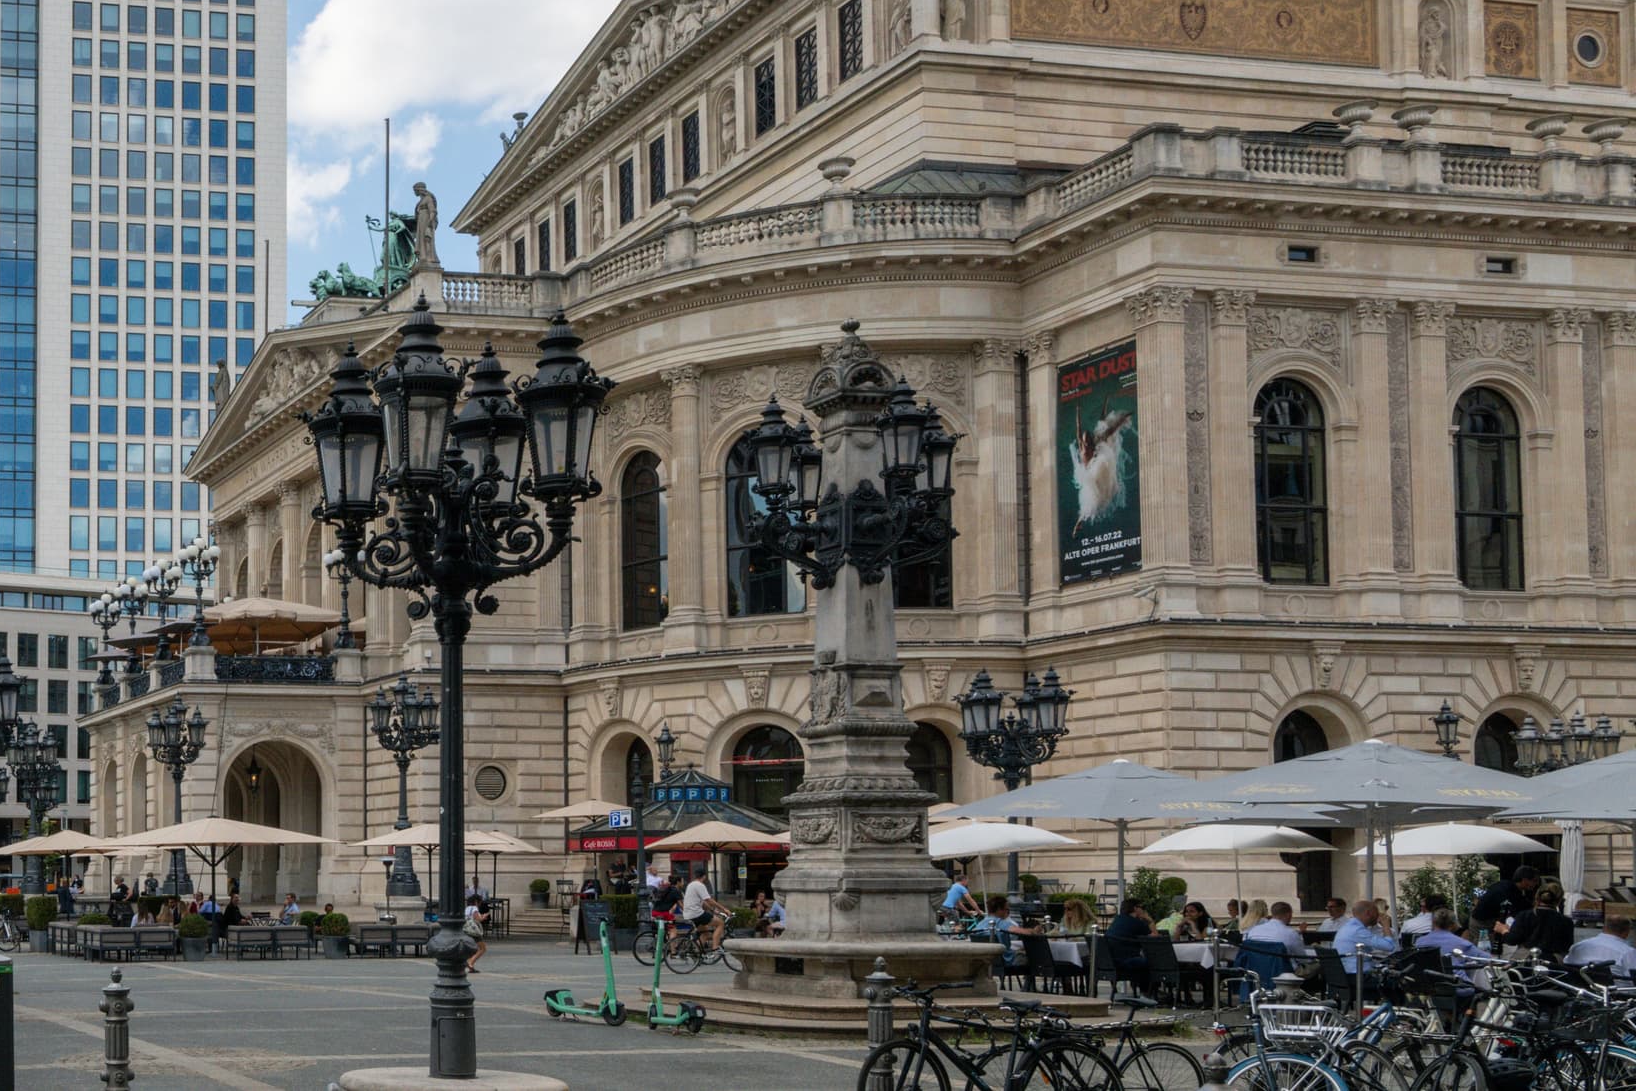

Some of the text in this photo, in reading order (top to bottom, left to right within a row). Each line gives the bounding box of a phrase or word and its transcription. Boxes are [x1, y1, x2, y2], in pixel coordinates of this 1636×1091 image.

[1061, 366, 1097, 392] STAR
[1099, 351, 1137, 379] DUST
[1064, 550, 1081, 561] ALTE
[1081, 546, 1100, 557] OPER
[1100, 537, 1141, 552] FRANKFURT
[672, 791, 680, 800] P
[689, 791, 697, 800] P
[706, 790, 714, 800] P
